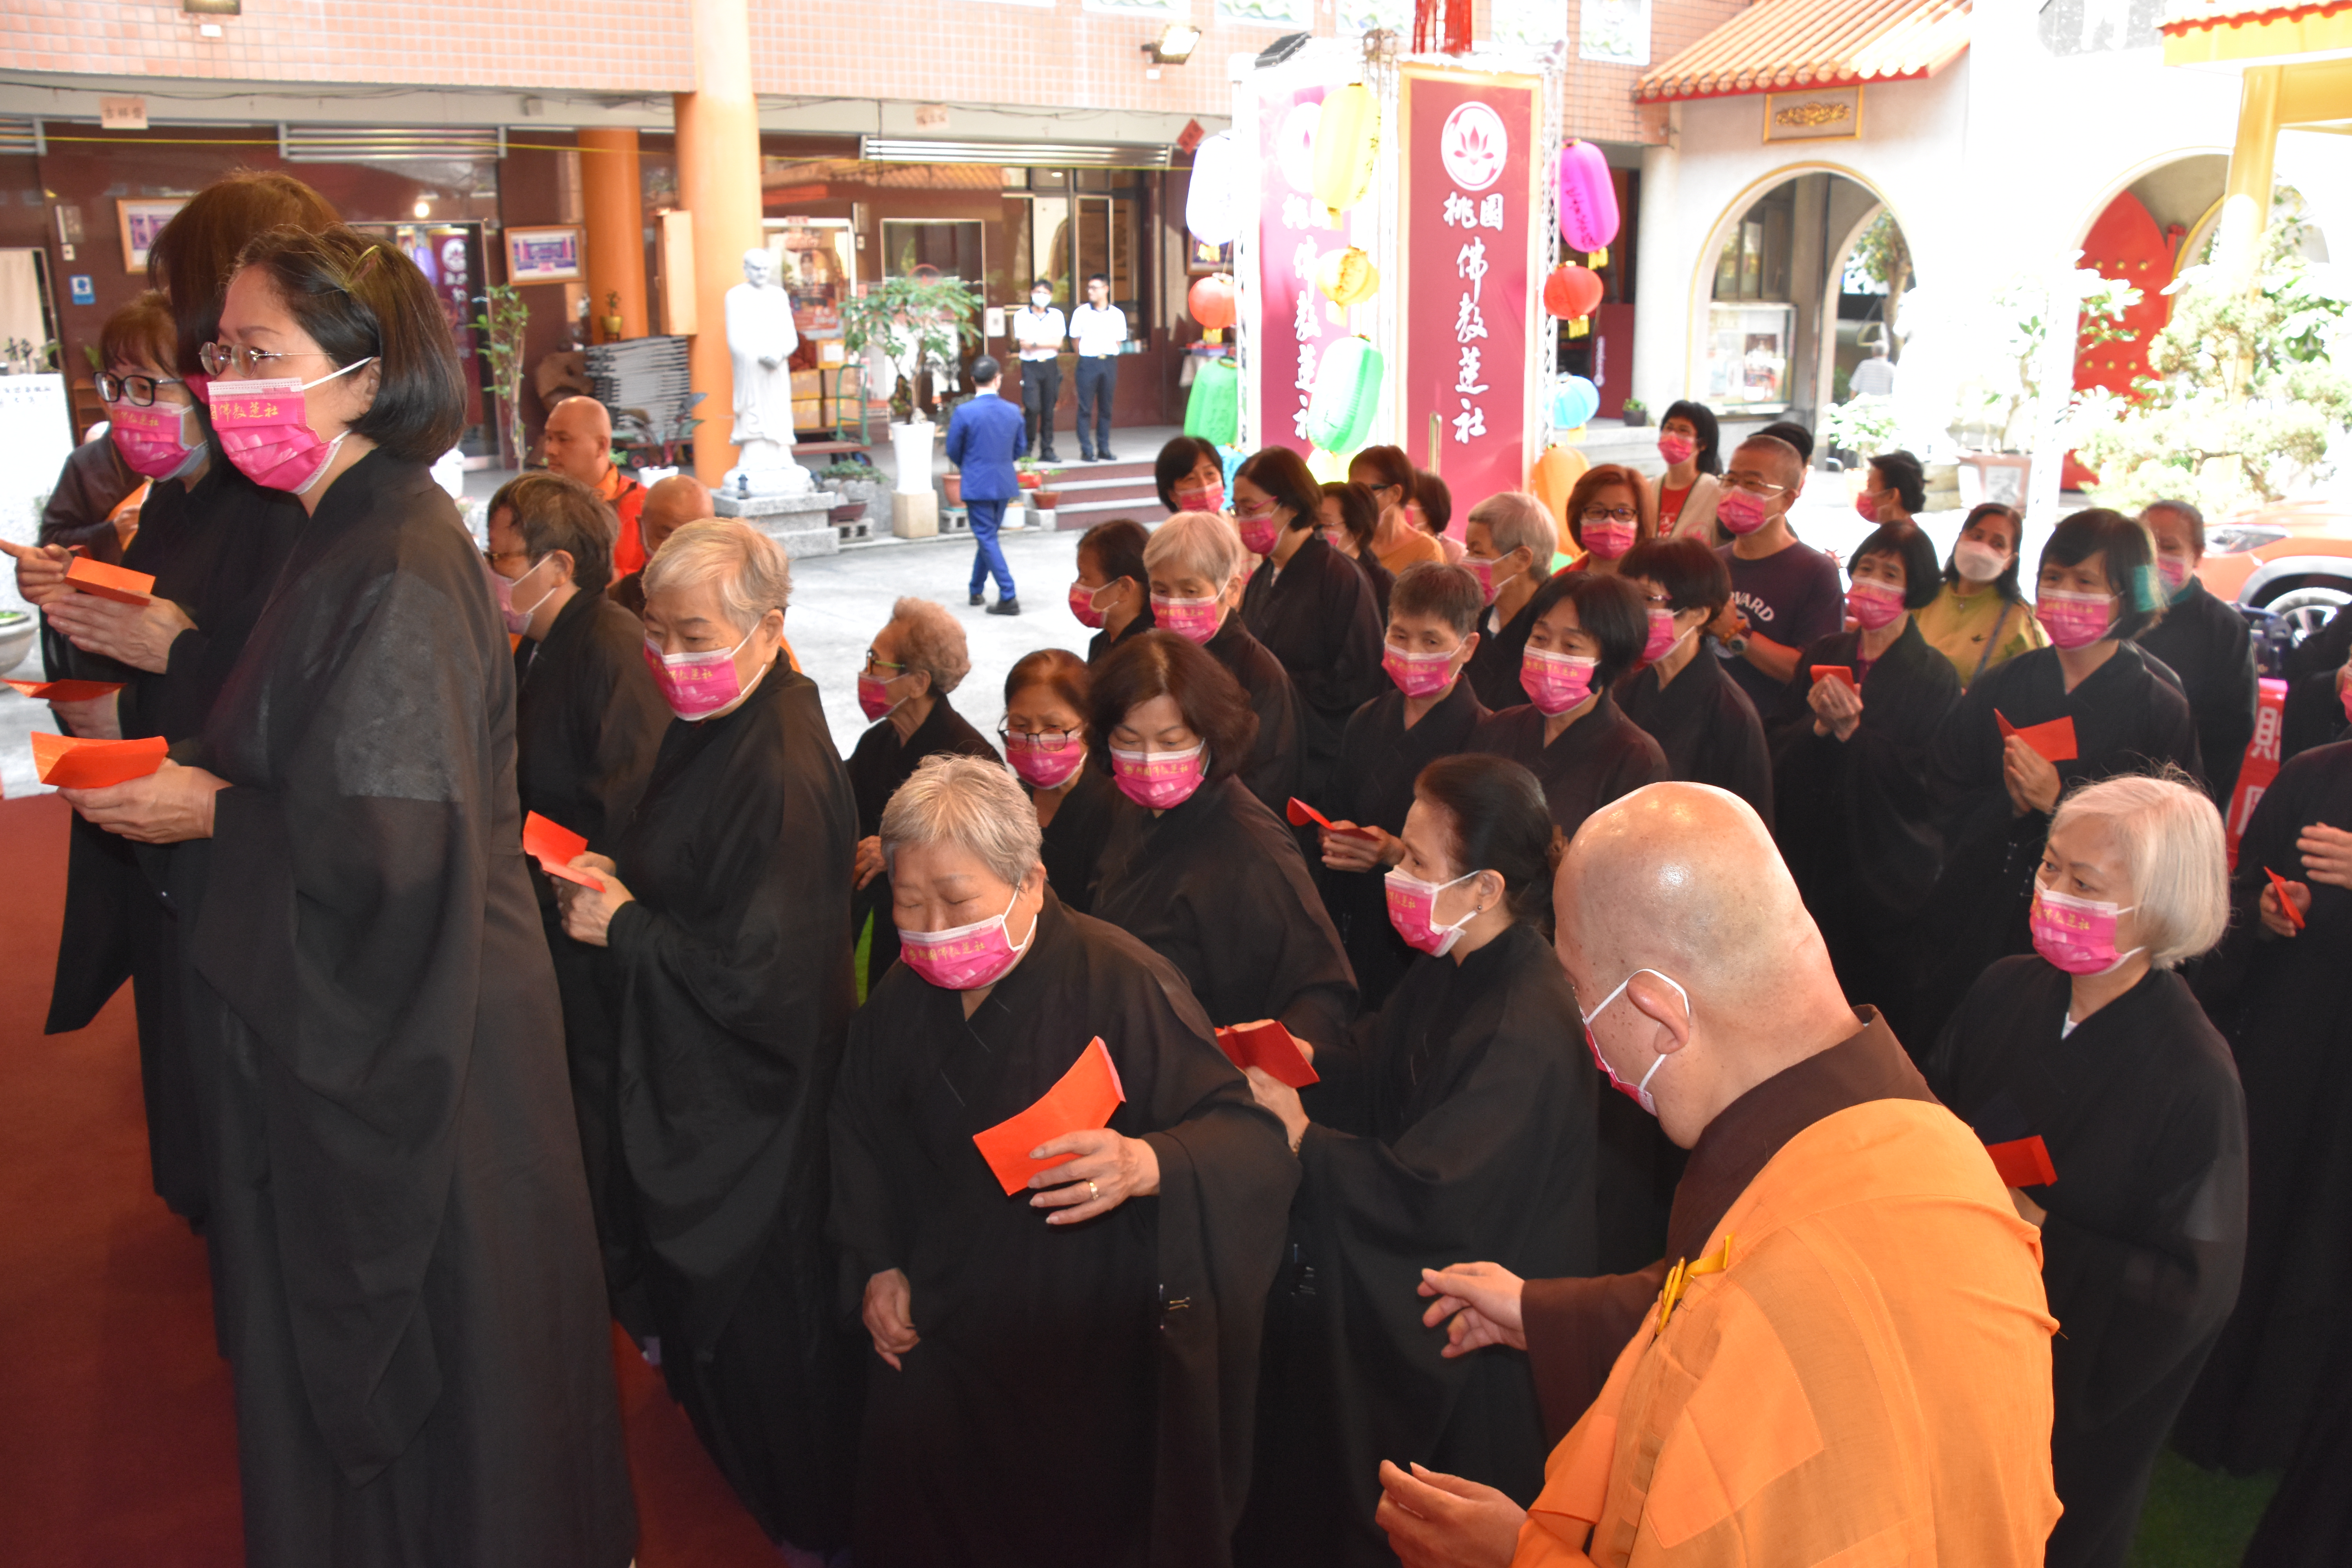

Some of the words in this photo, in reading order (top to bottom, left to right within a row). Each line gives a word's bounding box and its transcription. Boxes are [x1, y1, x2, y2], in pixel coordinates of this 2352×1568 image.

[1443, 191, 1504, 231] 桃園
[1452, 236, 1490, 445] 佛教蓮社
[1731, 591, 1775, 622] VARD
